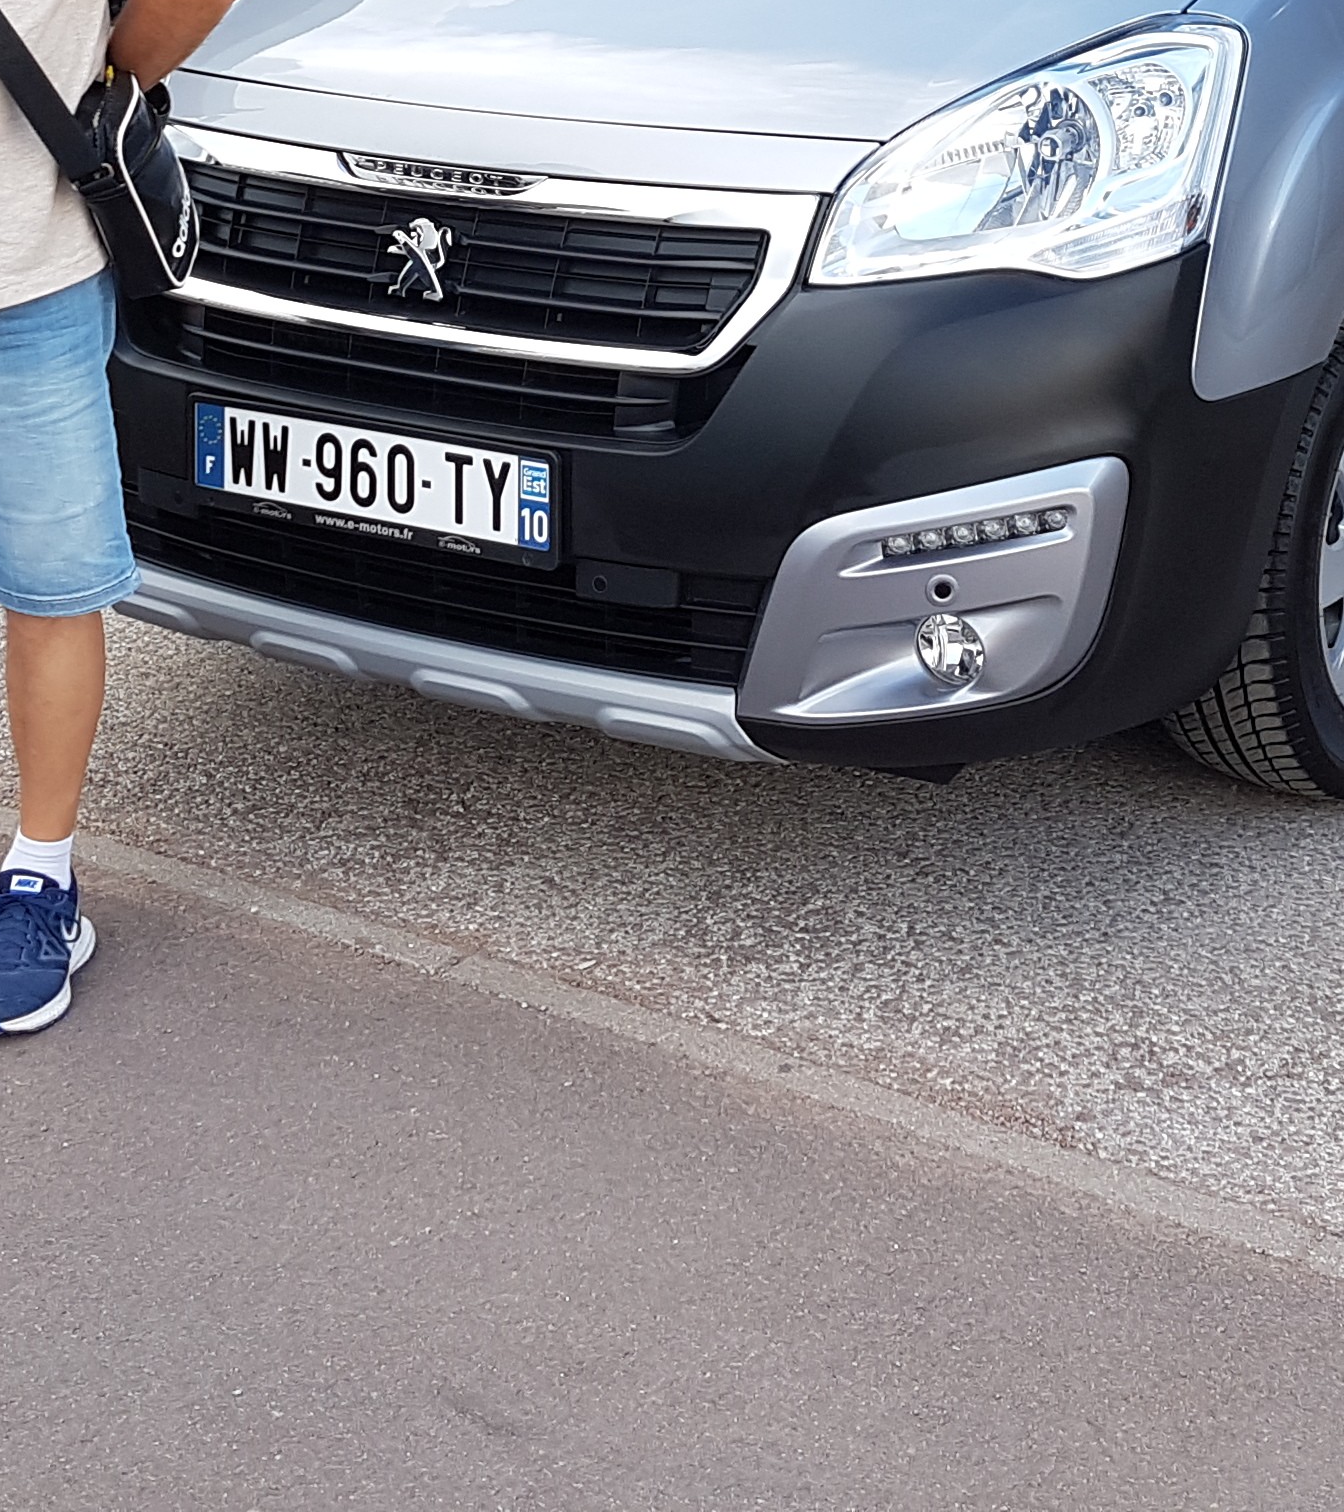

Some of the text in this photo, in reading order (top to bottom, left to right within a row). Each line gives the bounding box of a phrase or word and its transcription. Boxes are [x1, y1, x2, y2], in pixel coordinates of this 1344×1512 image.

[375, 160, 504, 187] PEUGEOT
[172, 191, 191, 258] adida
[205, 455, 216, 475] F
[523, 467, 547, 479] Grand
[523, 475, 546, 494] Est
[314, 514, 413, 541] www.e-motors.fr
[520, 507, 548, 543] 10
[15, 878, 39, 888] NIKE
